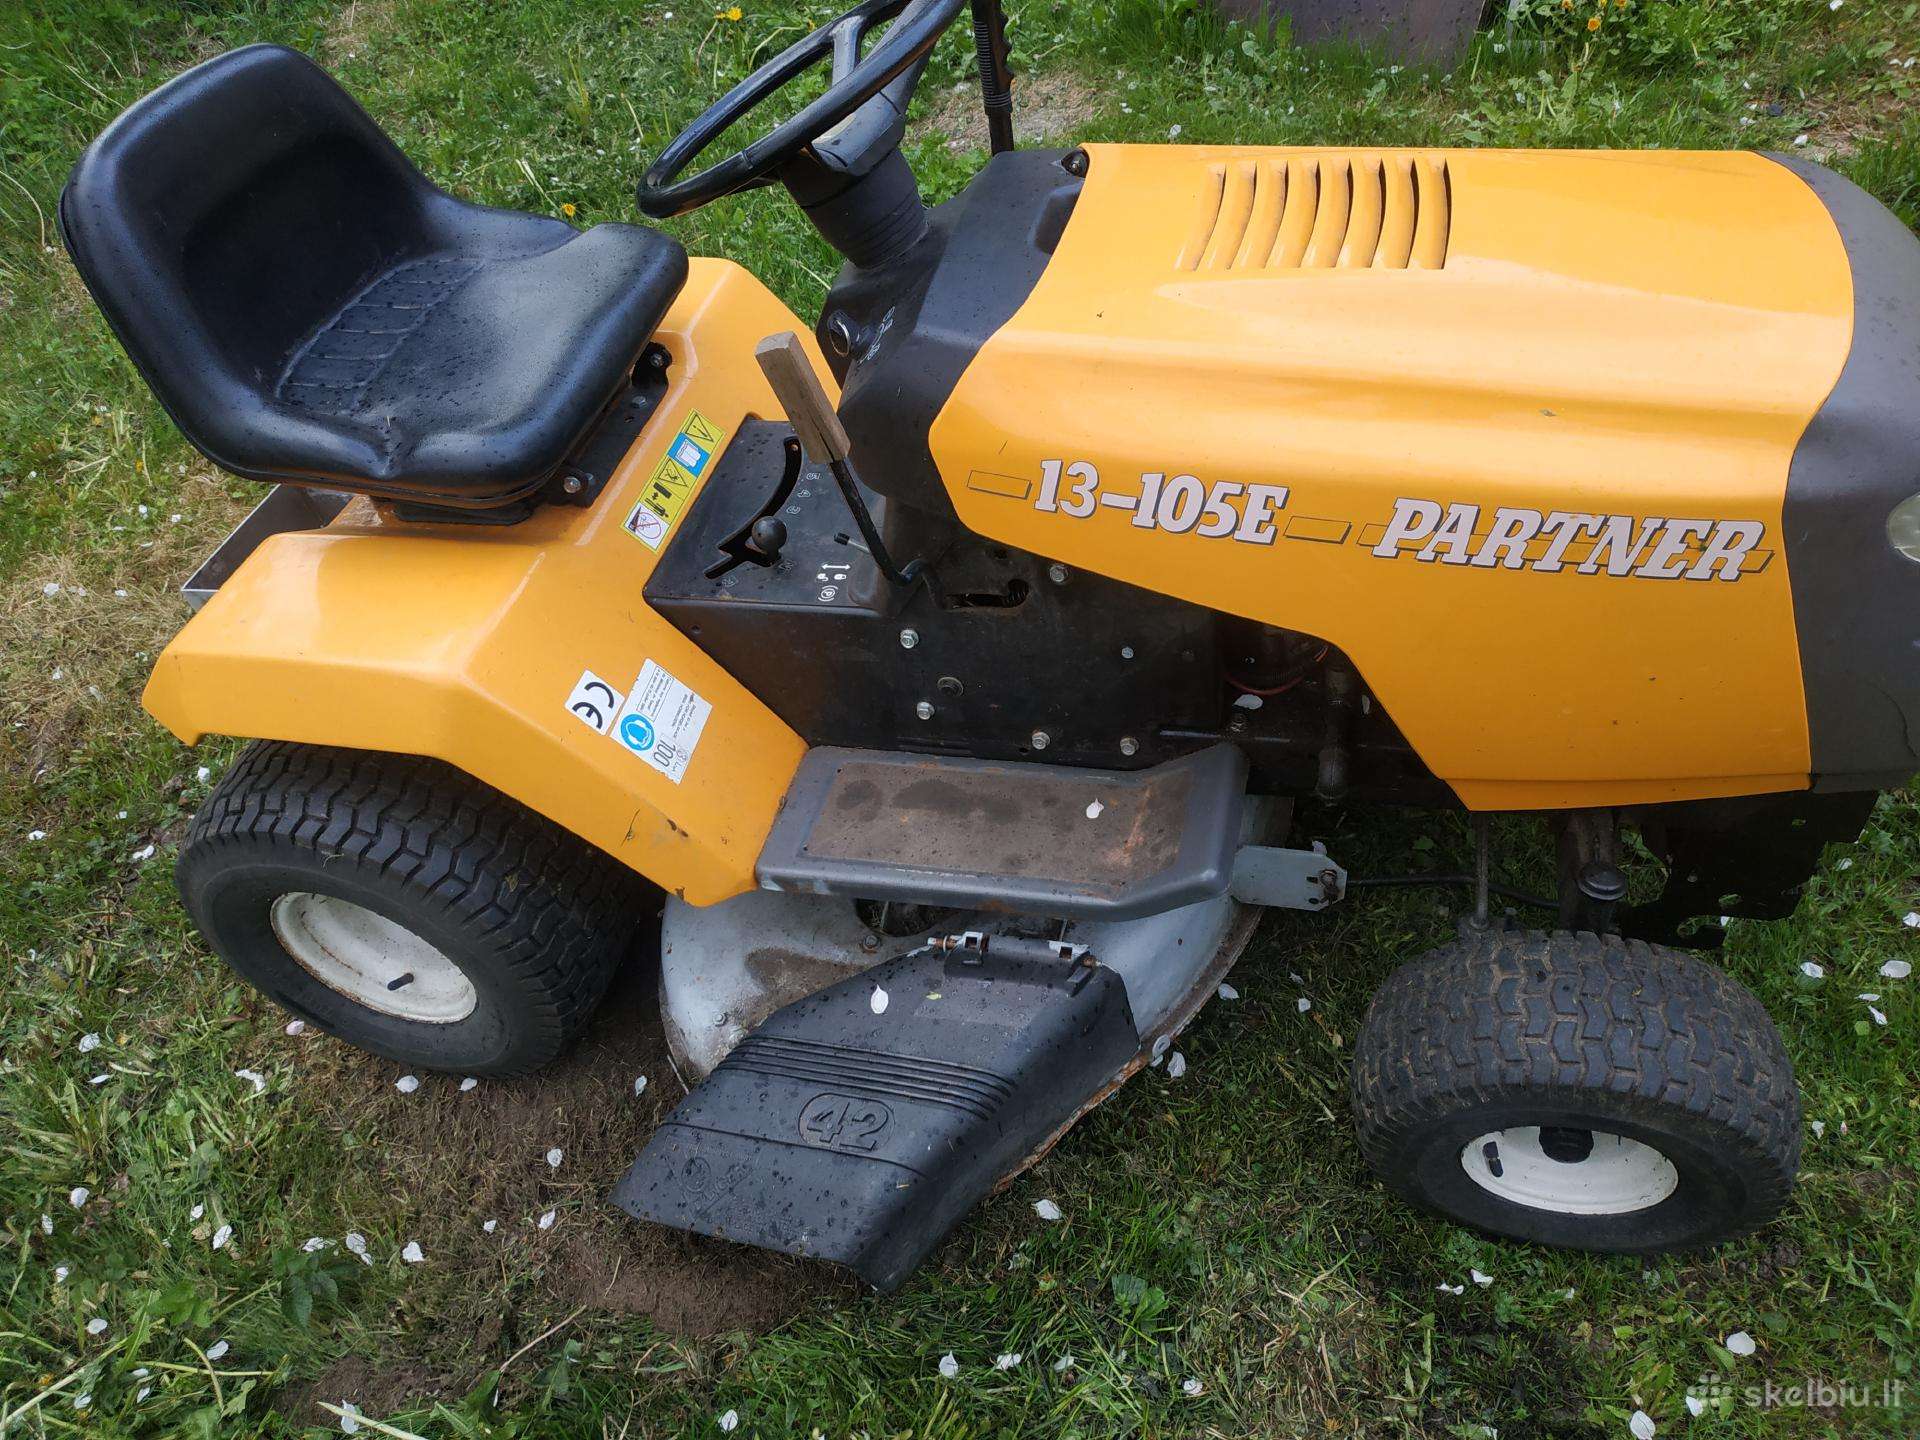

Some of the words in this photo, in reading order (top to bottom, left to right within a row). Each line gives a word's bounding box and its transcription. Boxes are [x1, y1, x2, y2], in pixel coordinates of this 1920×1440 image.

[1034, 459, 1289, 545] 13-105E
[1371, 497, 1766, 582] PARTNER
[572, 681, 615, 729] CE
[654, 739, 676, 768] 100
[806, 1100, 888, 1152] 42
